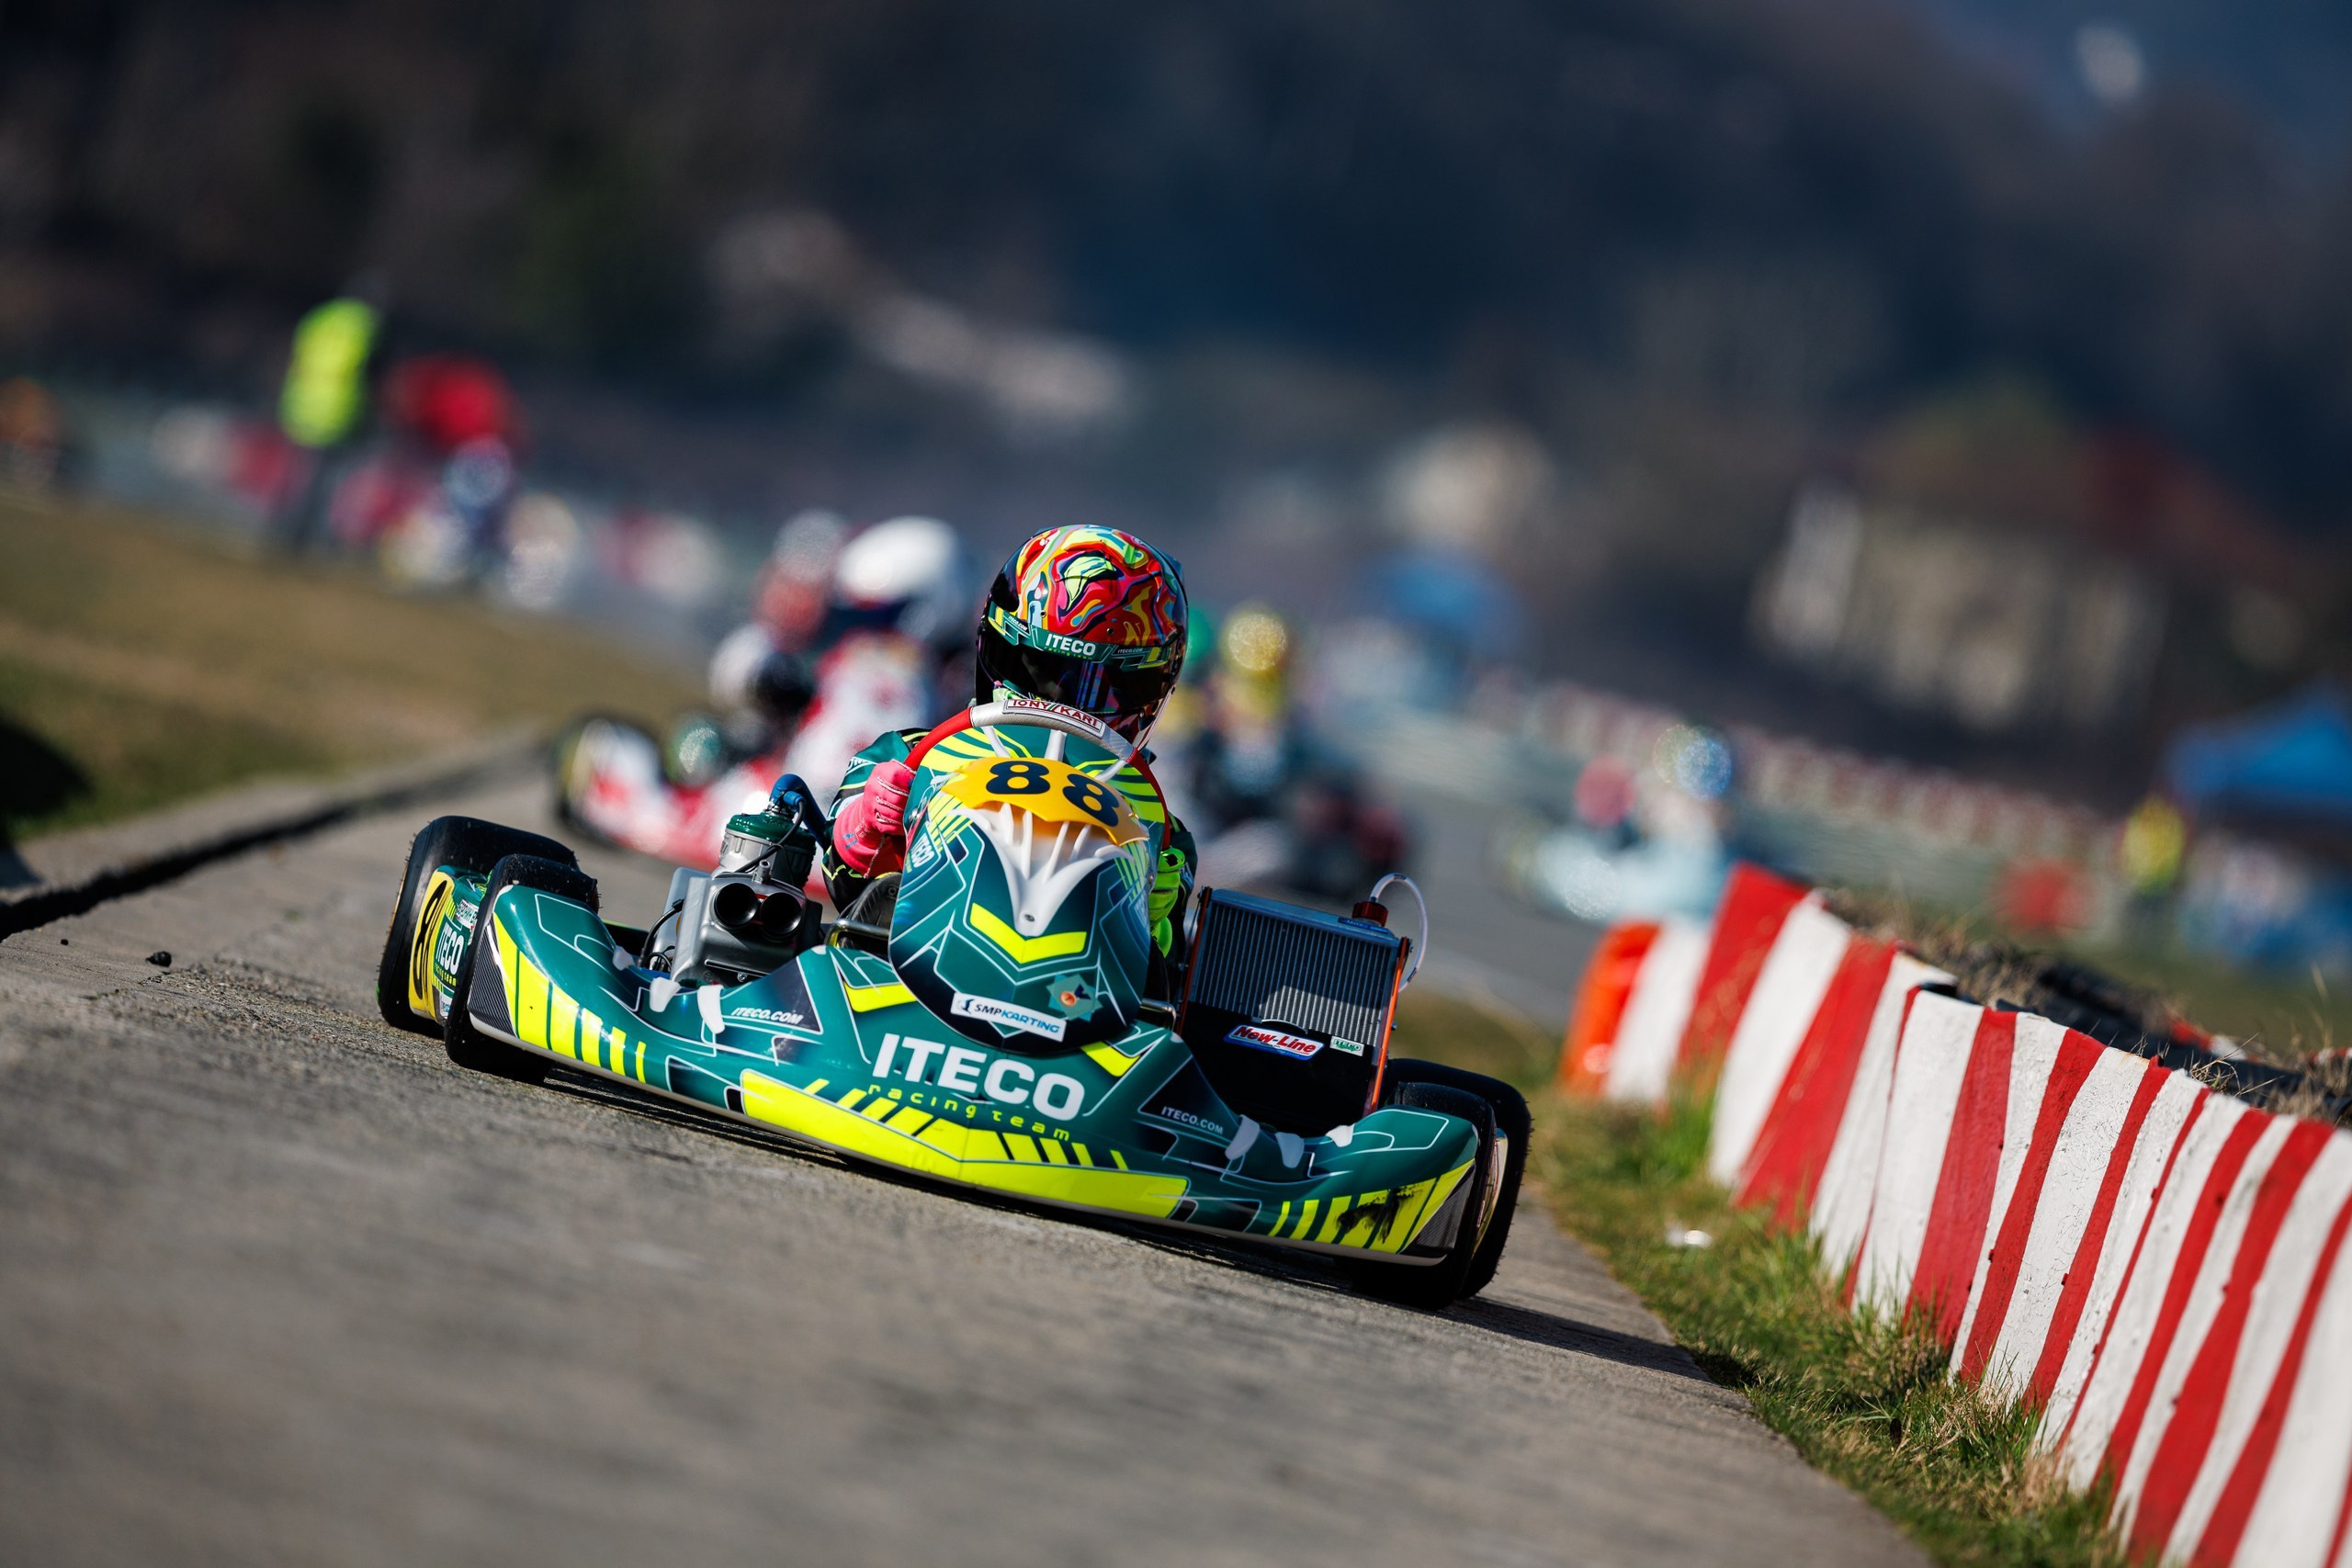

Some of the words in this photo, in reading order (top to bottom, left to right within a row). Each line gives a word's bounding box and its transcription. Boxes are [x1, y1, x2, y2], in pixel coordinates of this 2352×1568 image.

[1046, 633, 1096, 656] ITECO
[986, 761, 1120, 827] 88
[436, 923, 464, 975] ITECO
[731, 1008, 804, 1024] ITECO.COM
[974, 1004, 1060, 1033] SMPKARTING
[1234, 1026, 1317, 1053] New-Line
[873, 1032, 1085, 1121] ITECO
[867, 1084, 977, 1119] racing
[992, 1110, 1070, 1141] team
[1161, 1106, 1224, 1134] ITECO.COM
